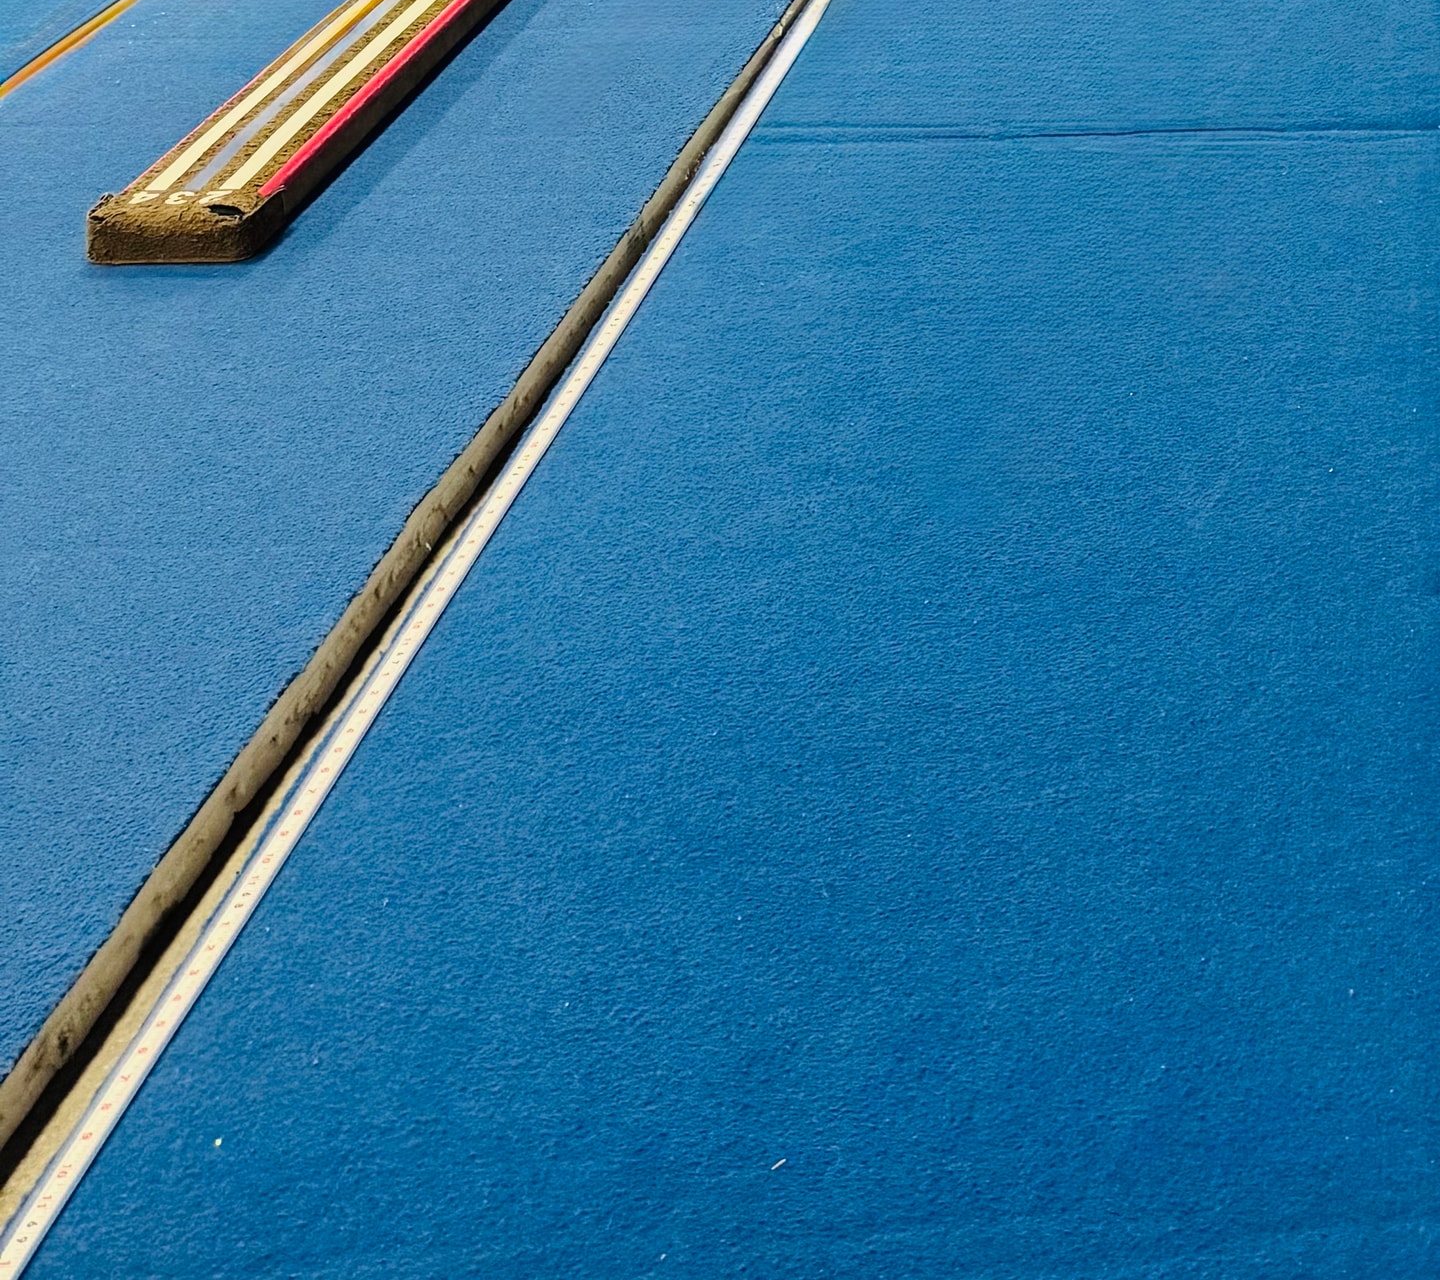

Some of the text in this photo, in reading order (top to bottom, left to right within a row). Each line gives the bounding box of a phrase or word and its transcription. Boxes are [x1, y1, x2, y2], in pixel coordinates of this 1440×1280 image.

[128, 190, 233, 205] 2 3 4
